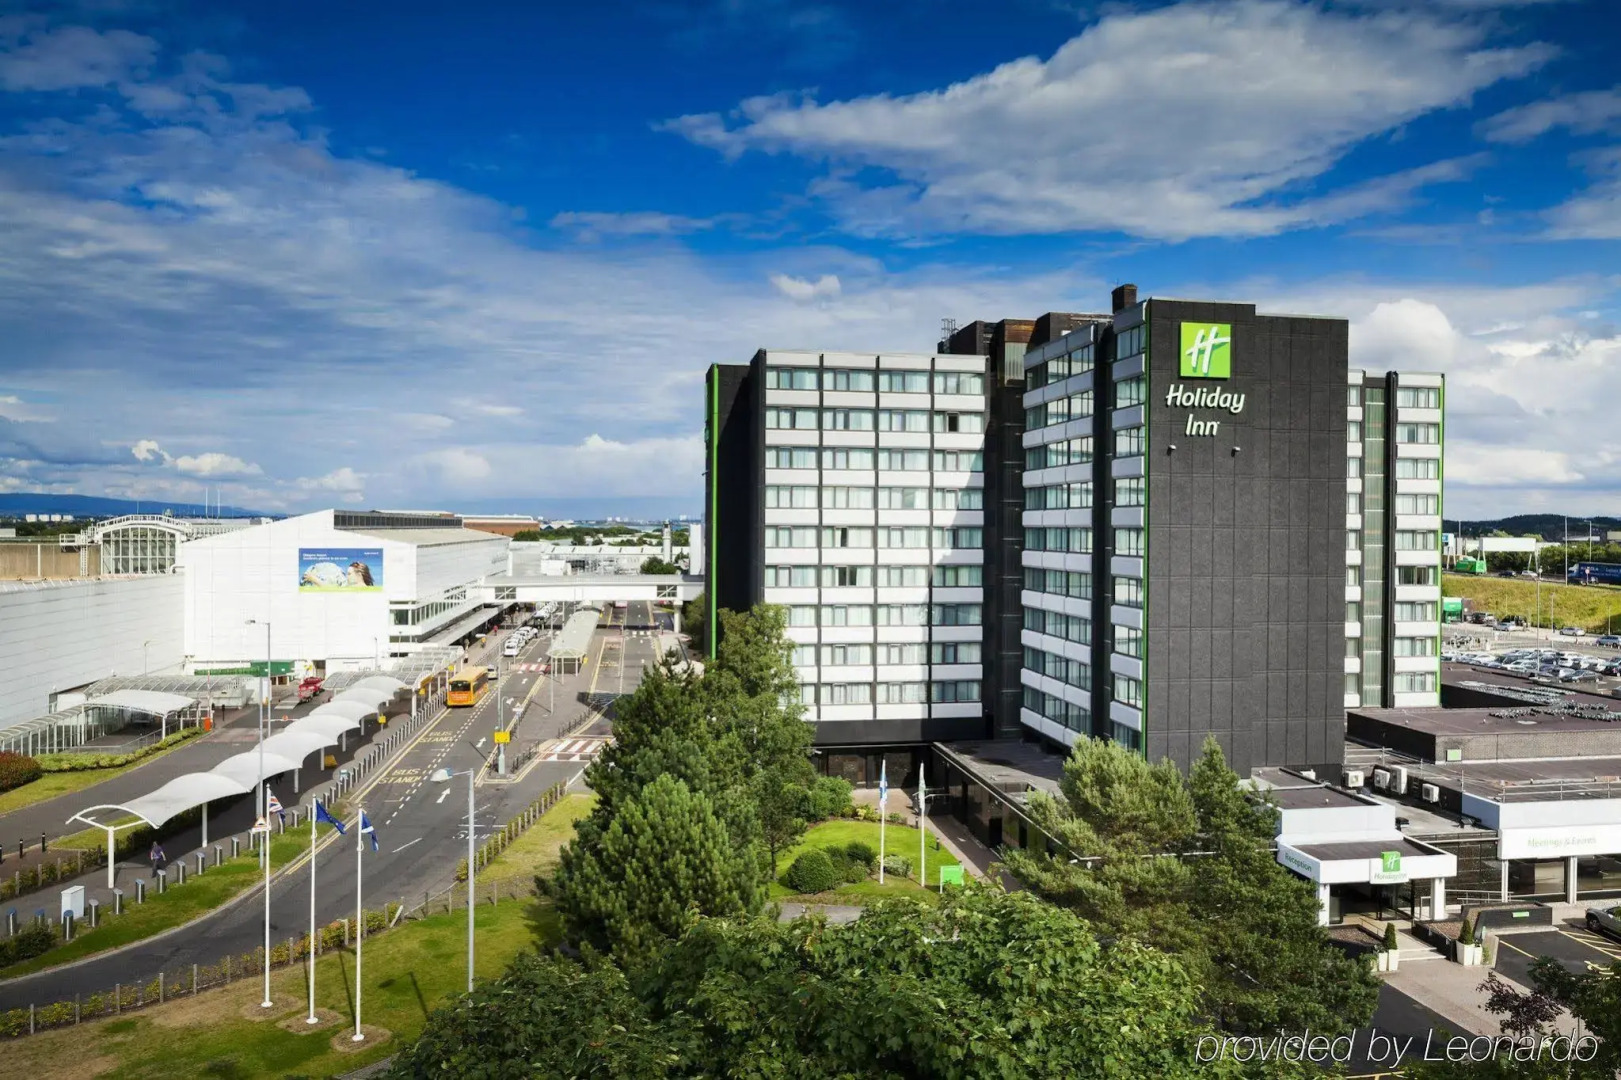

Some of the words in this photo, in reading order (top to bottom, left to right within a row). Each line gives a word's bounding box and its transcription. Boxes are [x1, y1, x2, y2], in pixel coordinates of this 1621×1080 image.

[1165, 384, 1245, 414] Holiday
[1185, 413, 1219, 436] Inn
[379, 775, 422, 784] STAND
[1285, 852, 1312, 872] Reception
